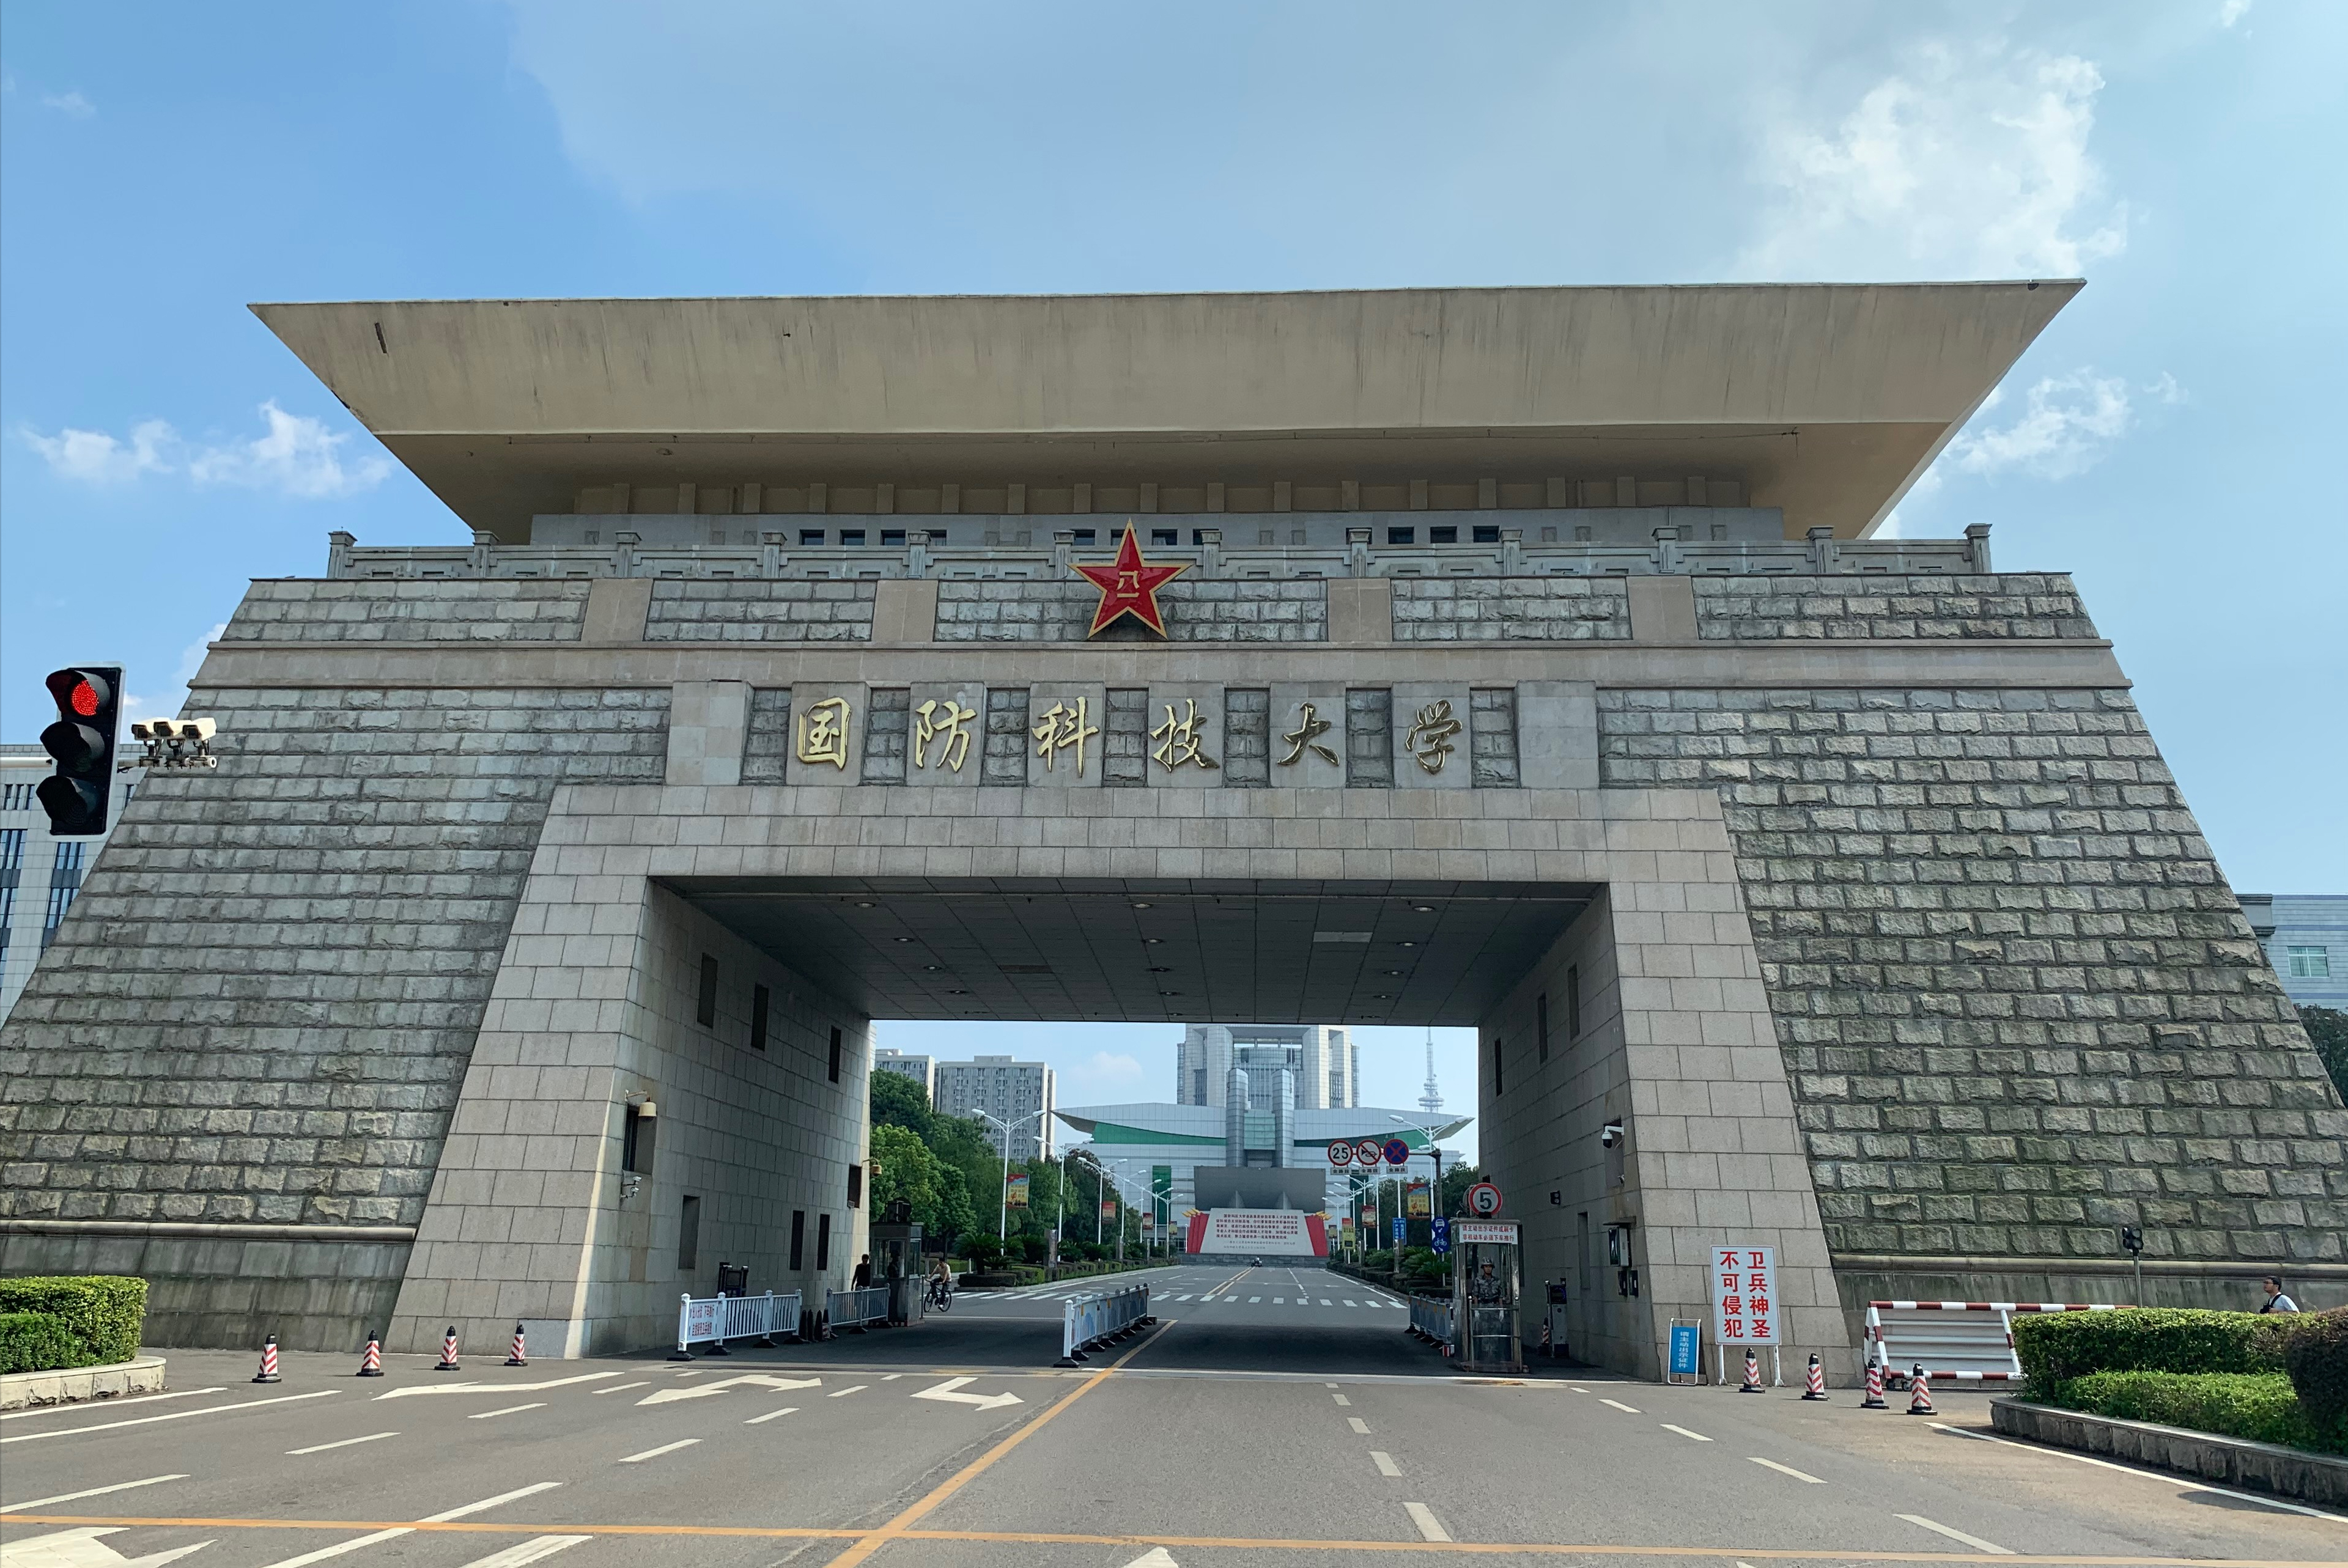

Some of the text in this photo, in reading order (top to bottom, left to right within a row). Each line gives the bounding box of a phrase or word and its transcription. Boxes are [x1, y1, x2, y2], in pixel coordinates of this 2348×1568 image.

[797, 696, 1464, 775] 国防科技大学
[1333, 1147, 1348, 1159] 25
[1480, 1192, 1492, 1210] 5
[1719, 1251, 1744, 1338] 不可侵犯
[1747, 1251, 1771, 1338] 卫兵神圣
